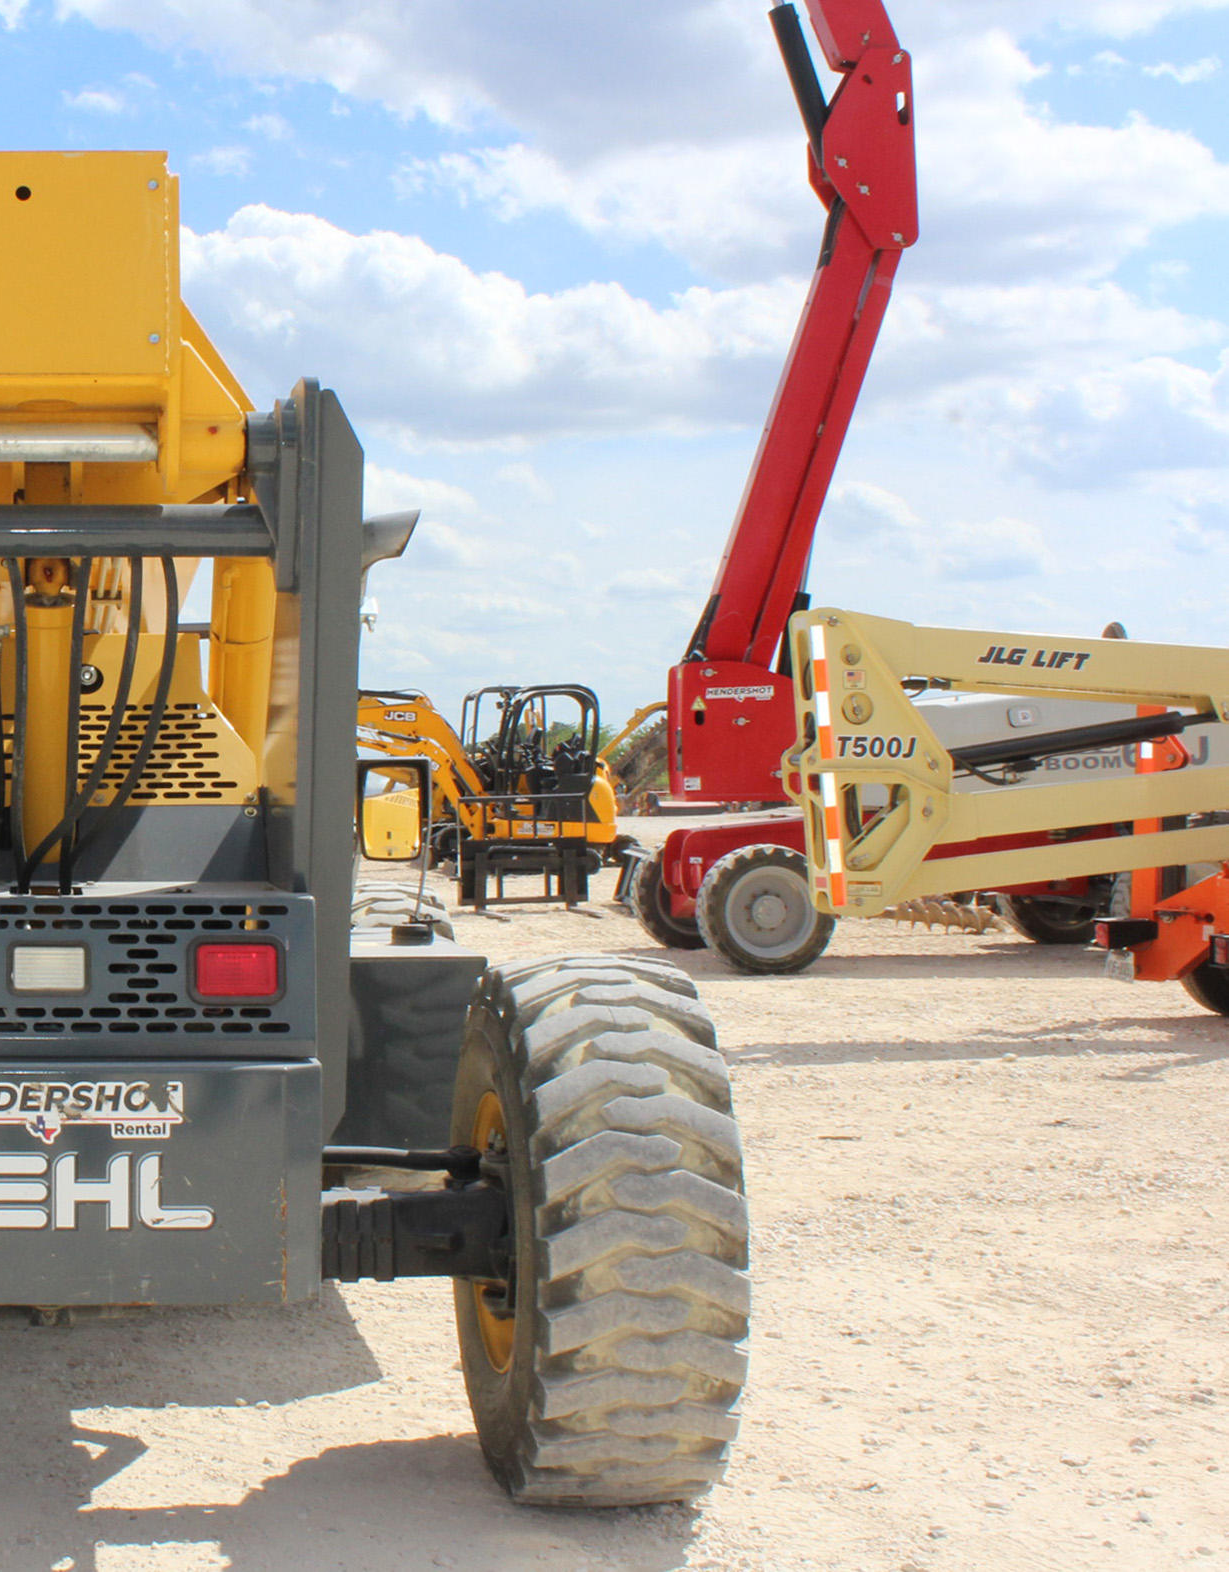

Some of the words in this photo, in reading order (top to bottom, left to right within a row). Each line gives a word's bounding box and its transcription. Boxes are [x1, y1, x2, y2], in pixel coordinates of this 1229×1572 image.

[976, 646, 1028, 666] JLG
[1031, 650, 1091, 671] LIFT
[706, 686, 773, 696] HENDERSHOT
[384, 711, 416, 721] JCB
[837, 736, 917, 758] T500J
[1045, 756, 1121, 771] BOOM
[114, 1122, 167, 1136] Rental
